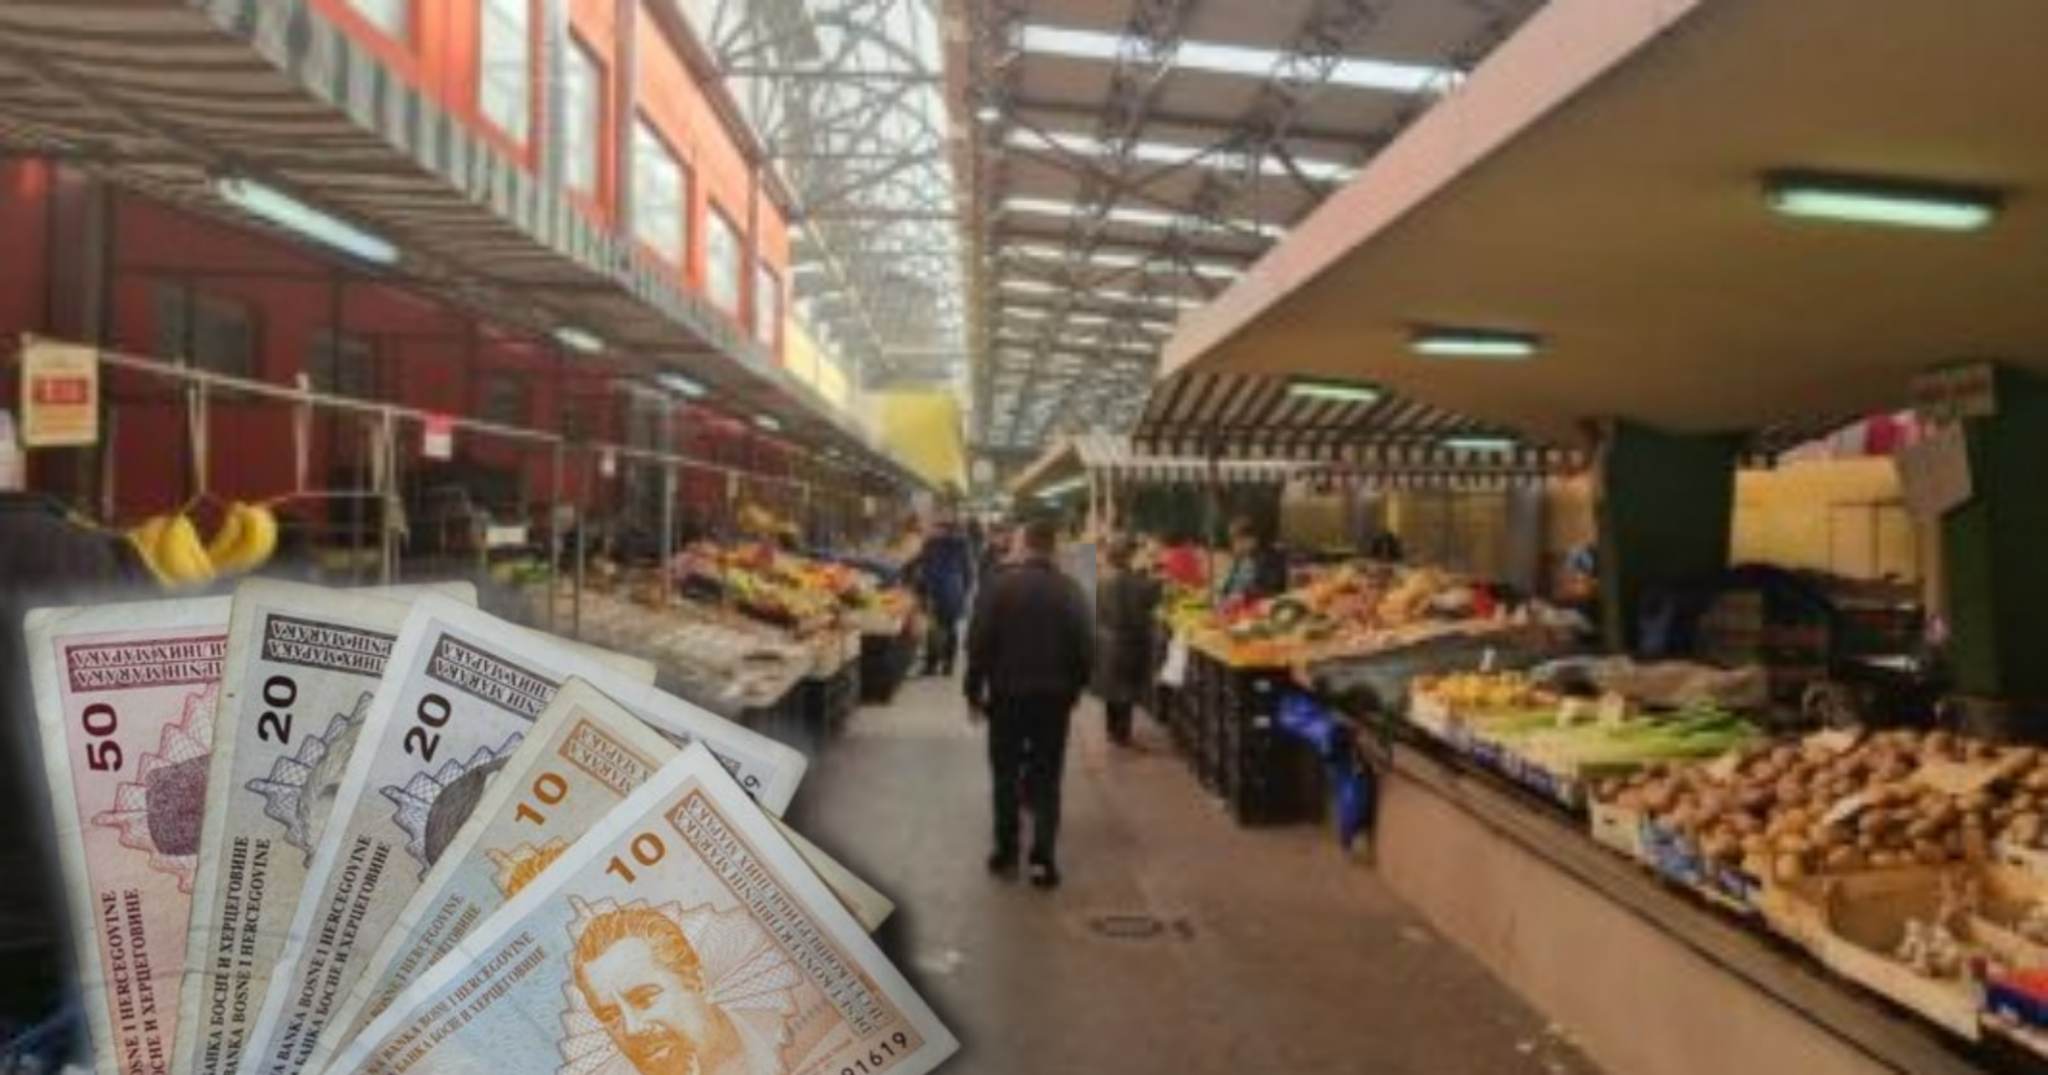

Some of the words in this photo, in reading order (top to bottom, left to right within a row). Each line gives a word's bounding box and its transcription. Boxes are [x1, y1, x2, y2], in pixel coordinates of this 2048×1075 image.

[270, 622, 347, 647] MARAKA
[76, 666, 161, 684] MARAKA
[258, 675, 298, 744] 20
[432, 657, 504, 700] MARAKA
[82, 703, 122, 772] 50
[403, 693, 451, 762] 20
[514, 771, 568, 826] 10
[605, 831, 667, 884] 10
[218, 834, 249, 953] ХЕРЦЕГОВИНЕ
[239, 837, 271, 956] HERCEGOVINE
[295, 954, 326, 1009] BOSNE
[318, 832, 372, 947] HERCEGOVINE
[101, 890, 134, 1020] HERCEGOVINE
[123, 888, 155, 1015] ХЕРЦЕГОВИНЕ
[230, 969, 251, 1023] BOSNE
